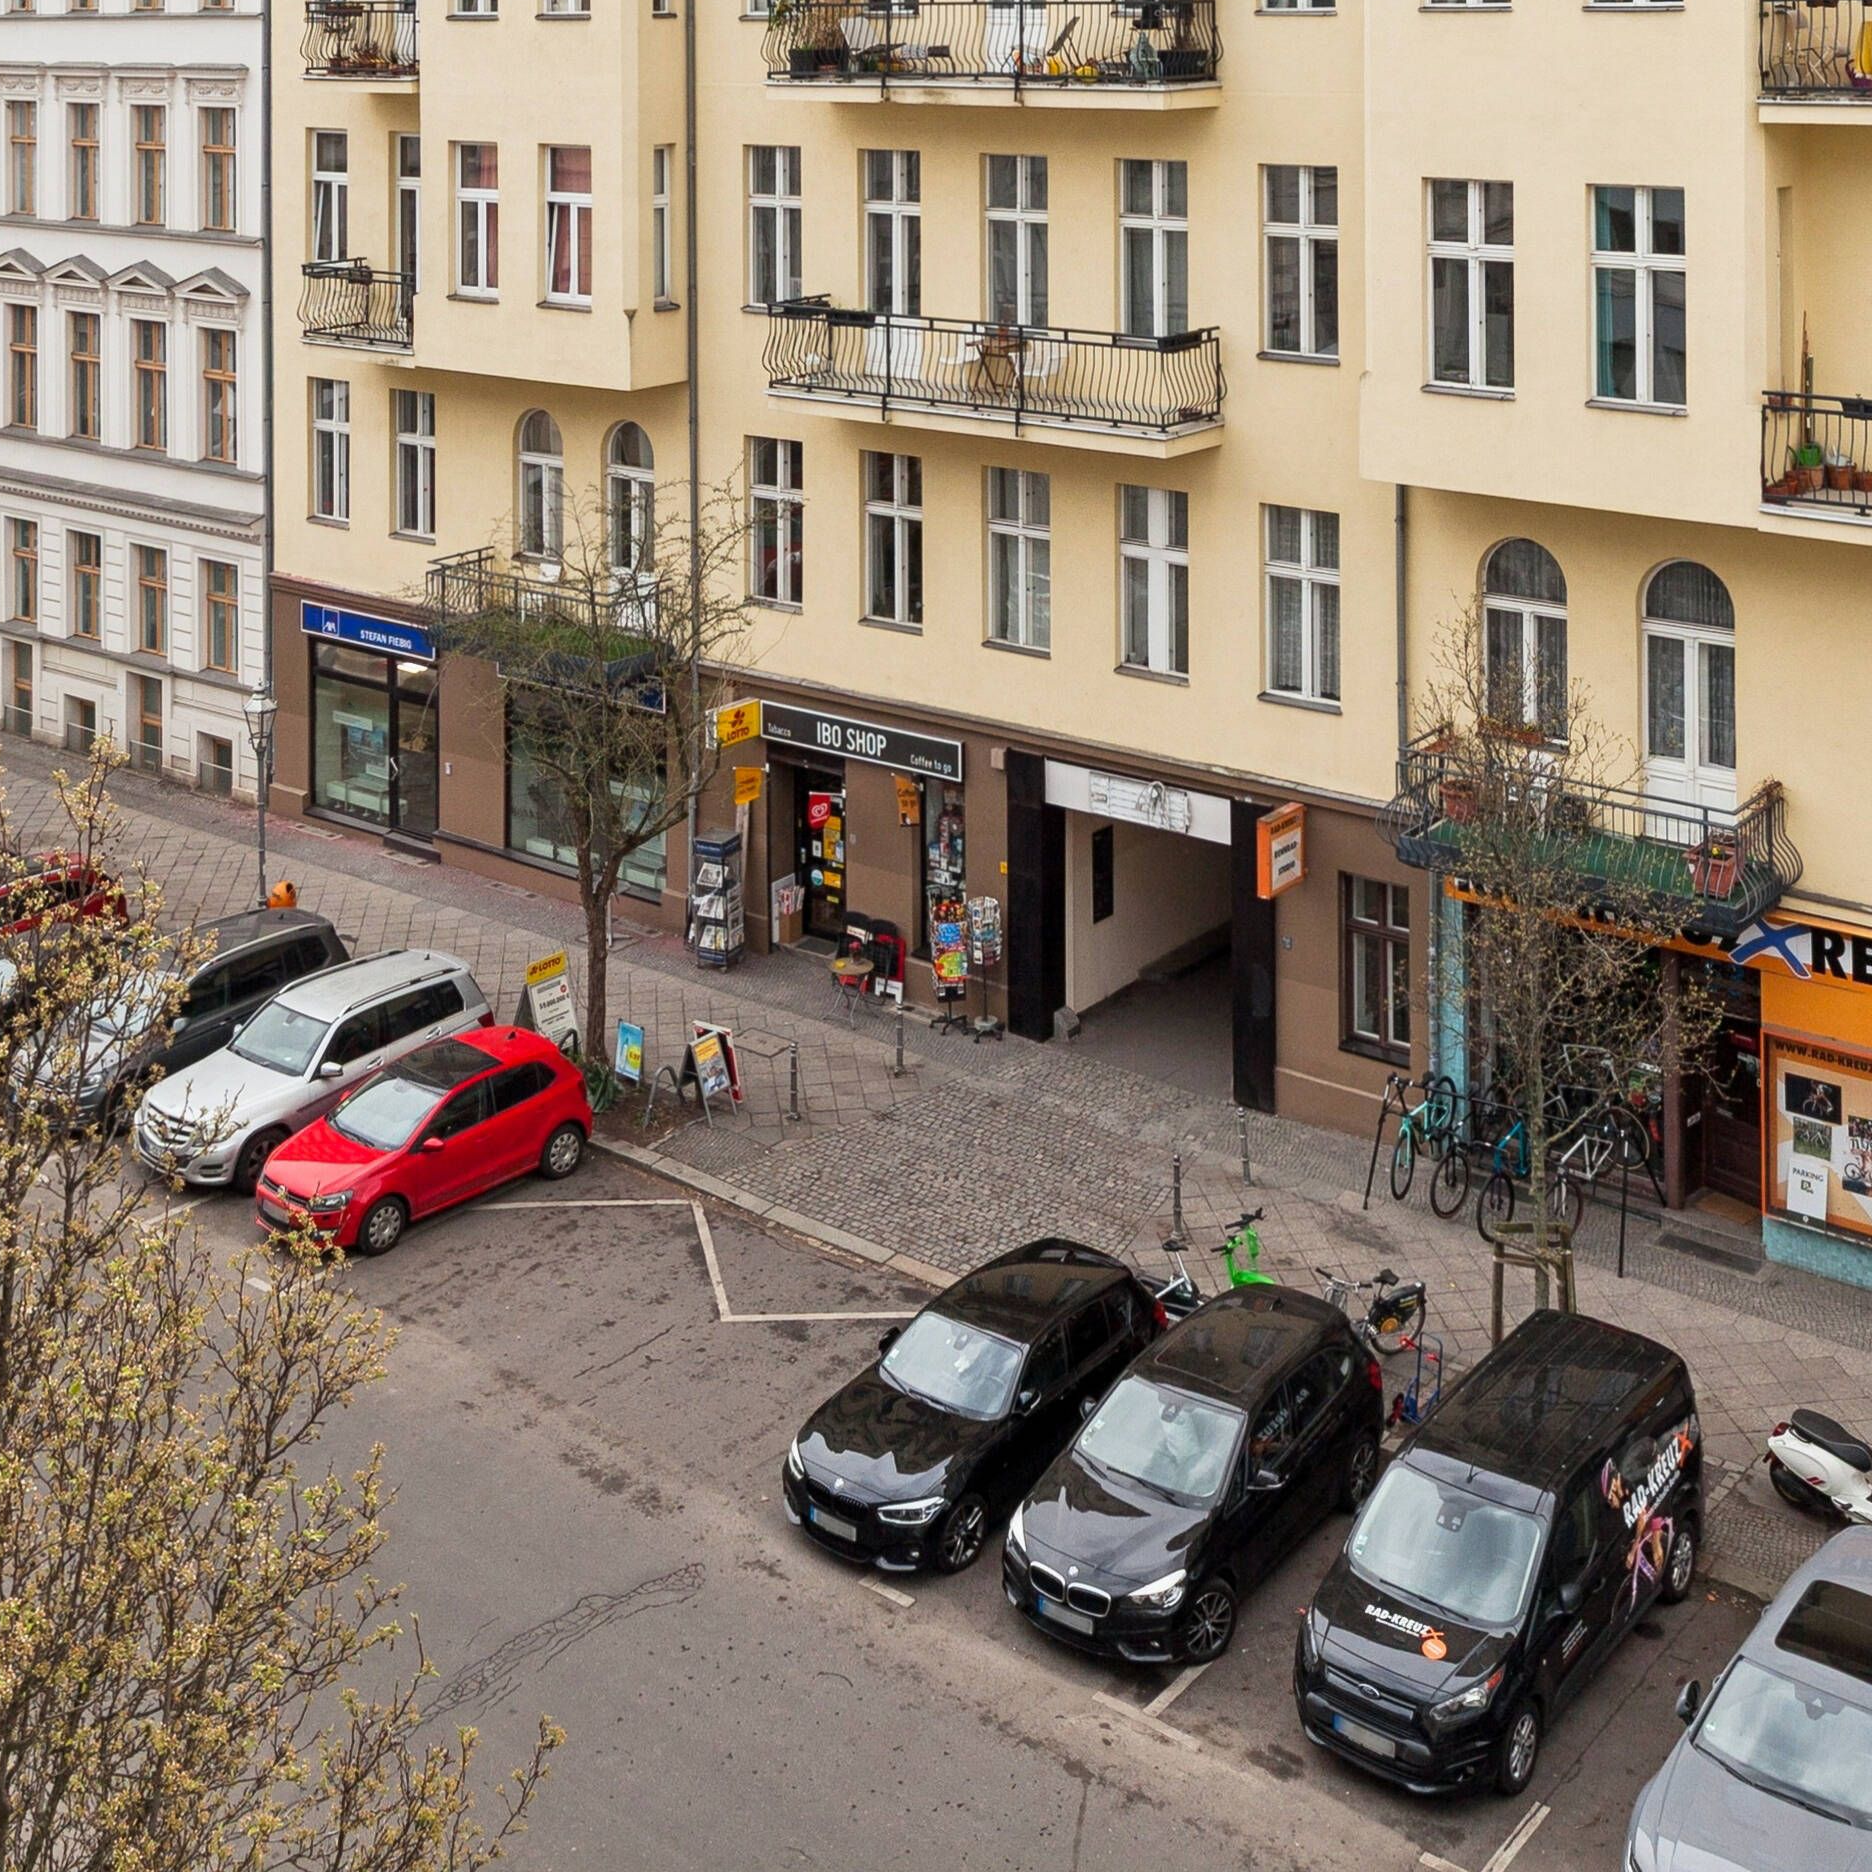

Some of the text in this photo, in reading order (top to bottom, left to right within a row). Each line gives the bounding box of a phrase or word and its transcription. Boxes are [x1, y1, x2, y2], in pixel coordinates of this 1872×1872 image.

[360, 630, 387, 644] STEFAN
[727, 727, 750, 741] LOTTO
[816, 721, 887, 757] IBO SHOP
[910, 754, 952, 774] Coffee to go
[539, 957, 561, 972] LOTTO
[1792, 1167, 1825, 1182] PARKING
[1623, 1436, 1682, 1529] RAD-KREUZ
[1364, 1603, 1430, 1636] RAD-KREUZ
